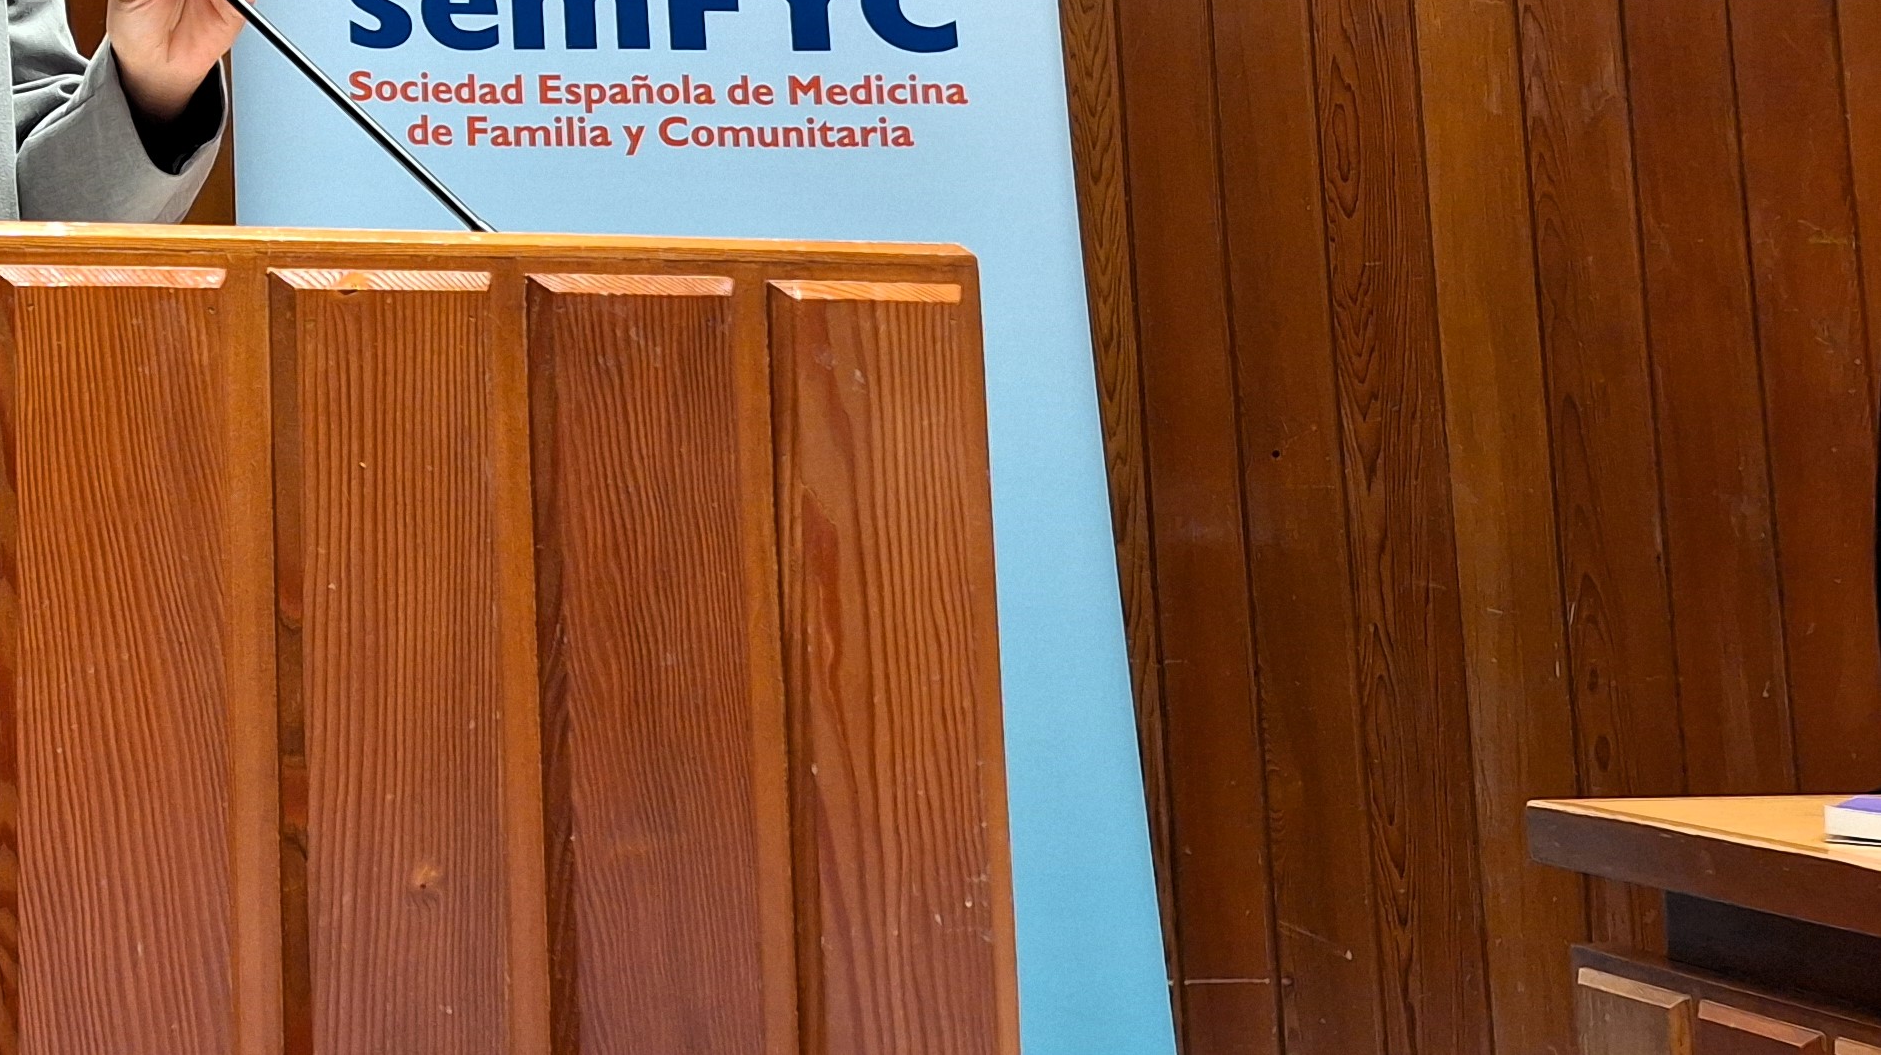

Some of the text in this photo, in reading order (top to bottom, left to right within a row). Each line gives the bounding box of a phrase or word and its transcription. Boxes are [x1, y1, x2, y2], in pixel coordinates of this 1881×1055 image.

[349, 71, 968, 114] Sociedad Española de Medicina
[407, 115, 915, 156] de Familia y Comunitaria
